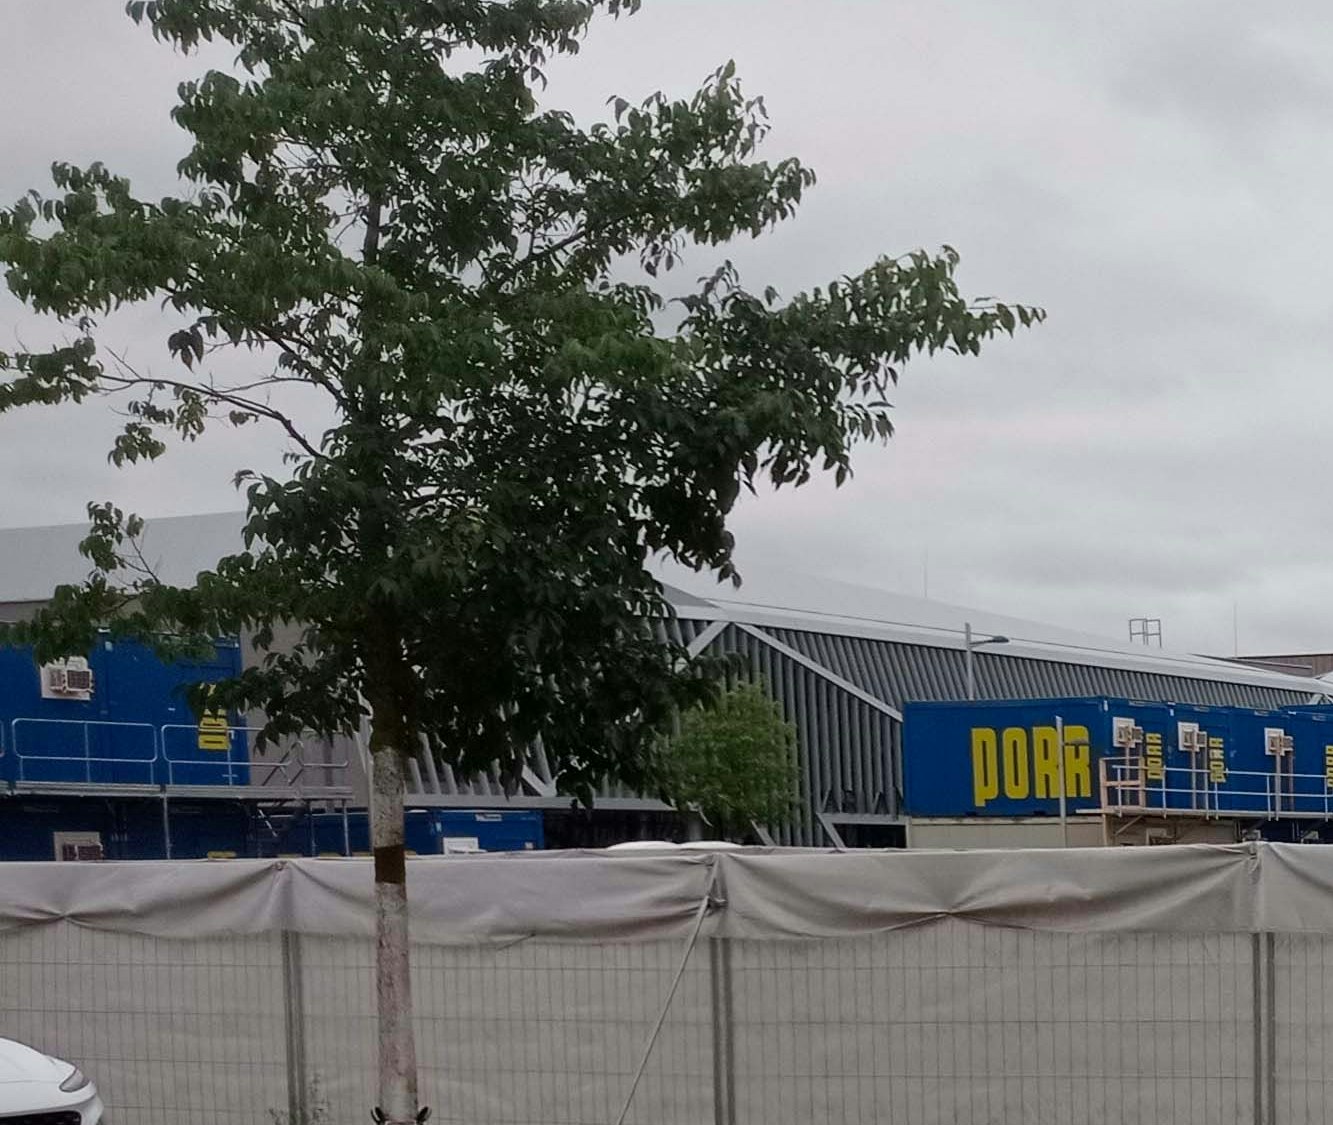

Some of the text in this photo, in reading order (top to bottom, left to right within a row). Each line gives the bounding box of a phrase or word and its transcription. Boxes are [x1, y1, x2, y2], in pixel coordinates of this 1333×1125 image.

[971, 725, 1092, 807] PORR
[1145, 732, 1163, 780] PORR
[1208, 736, 1227, 783] PORR
